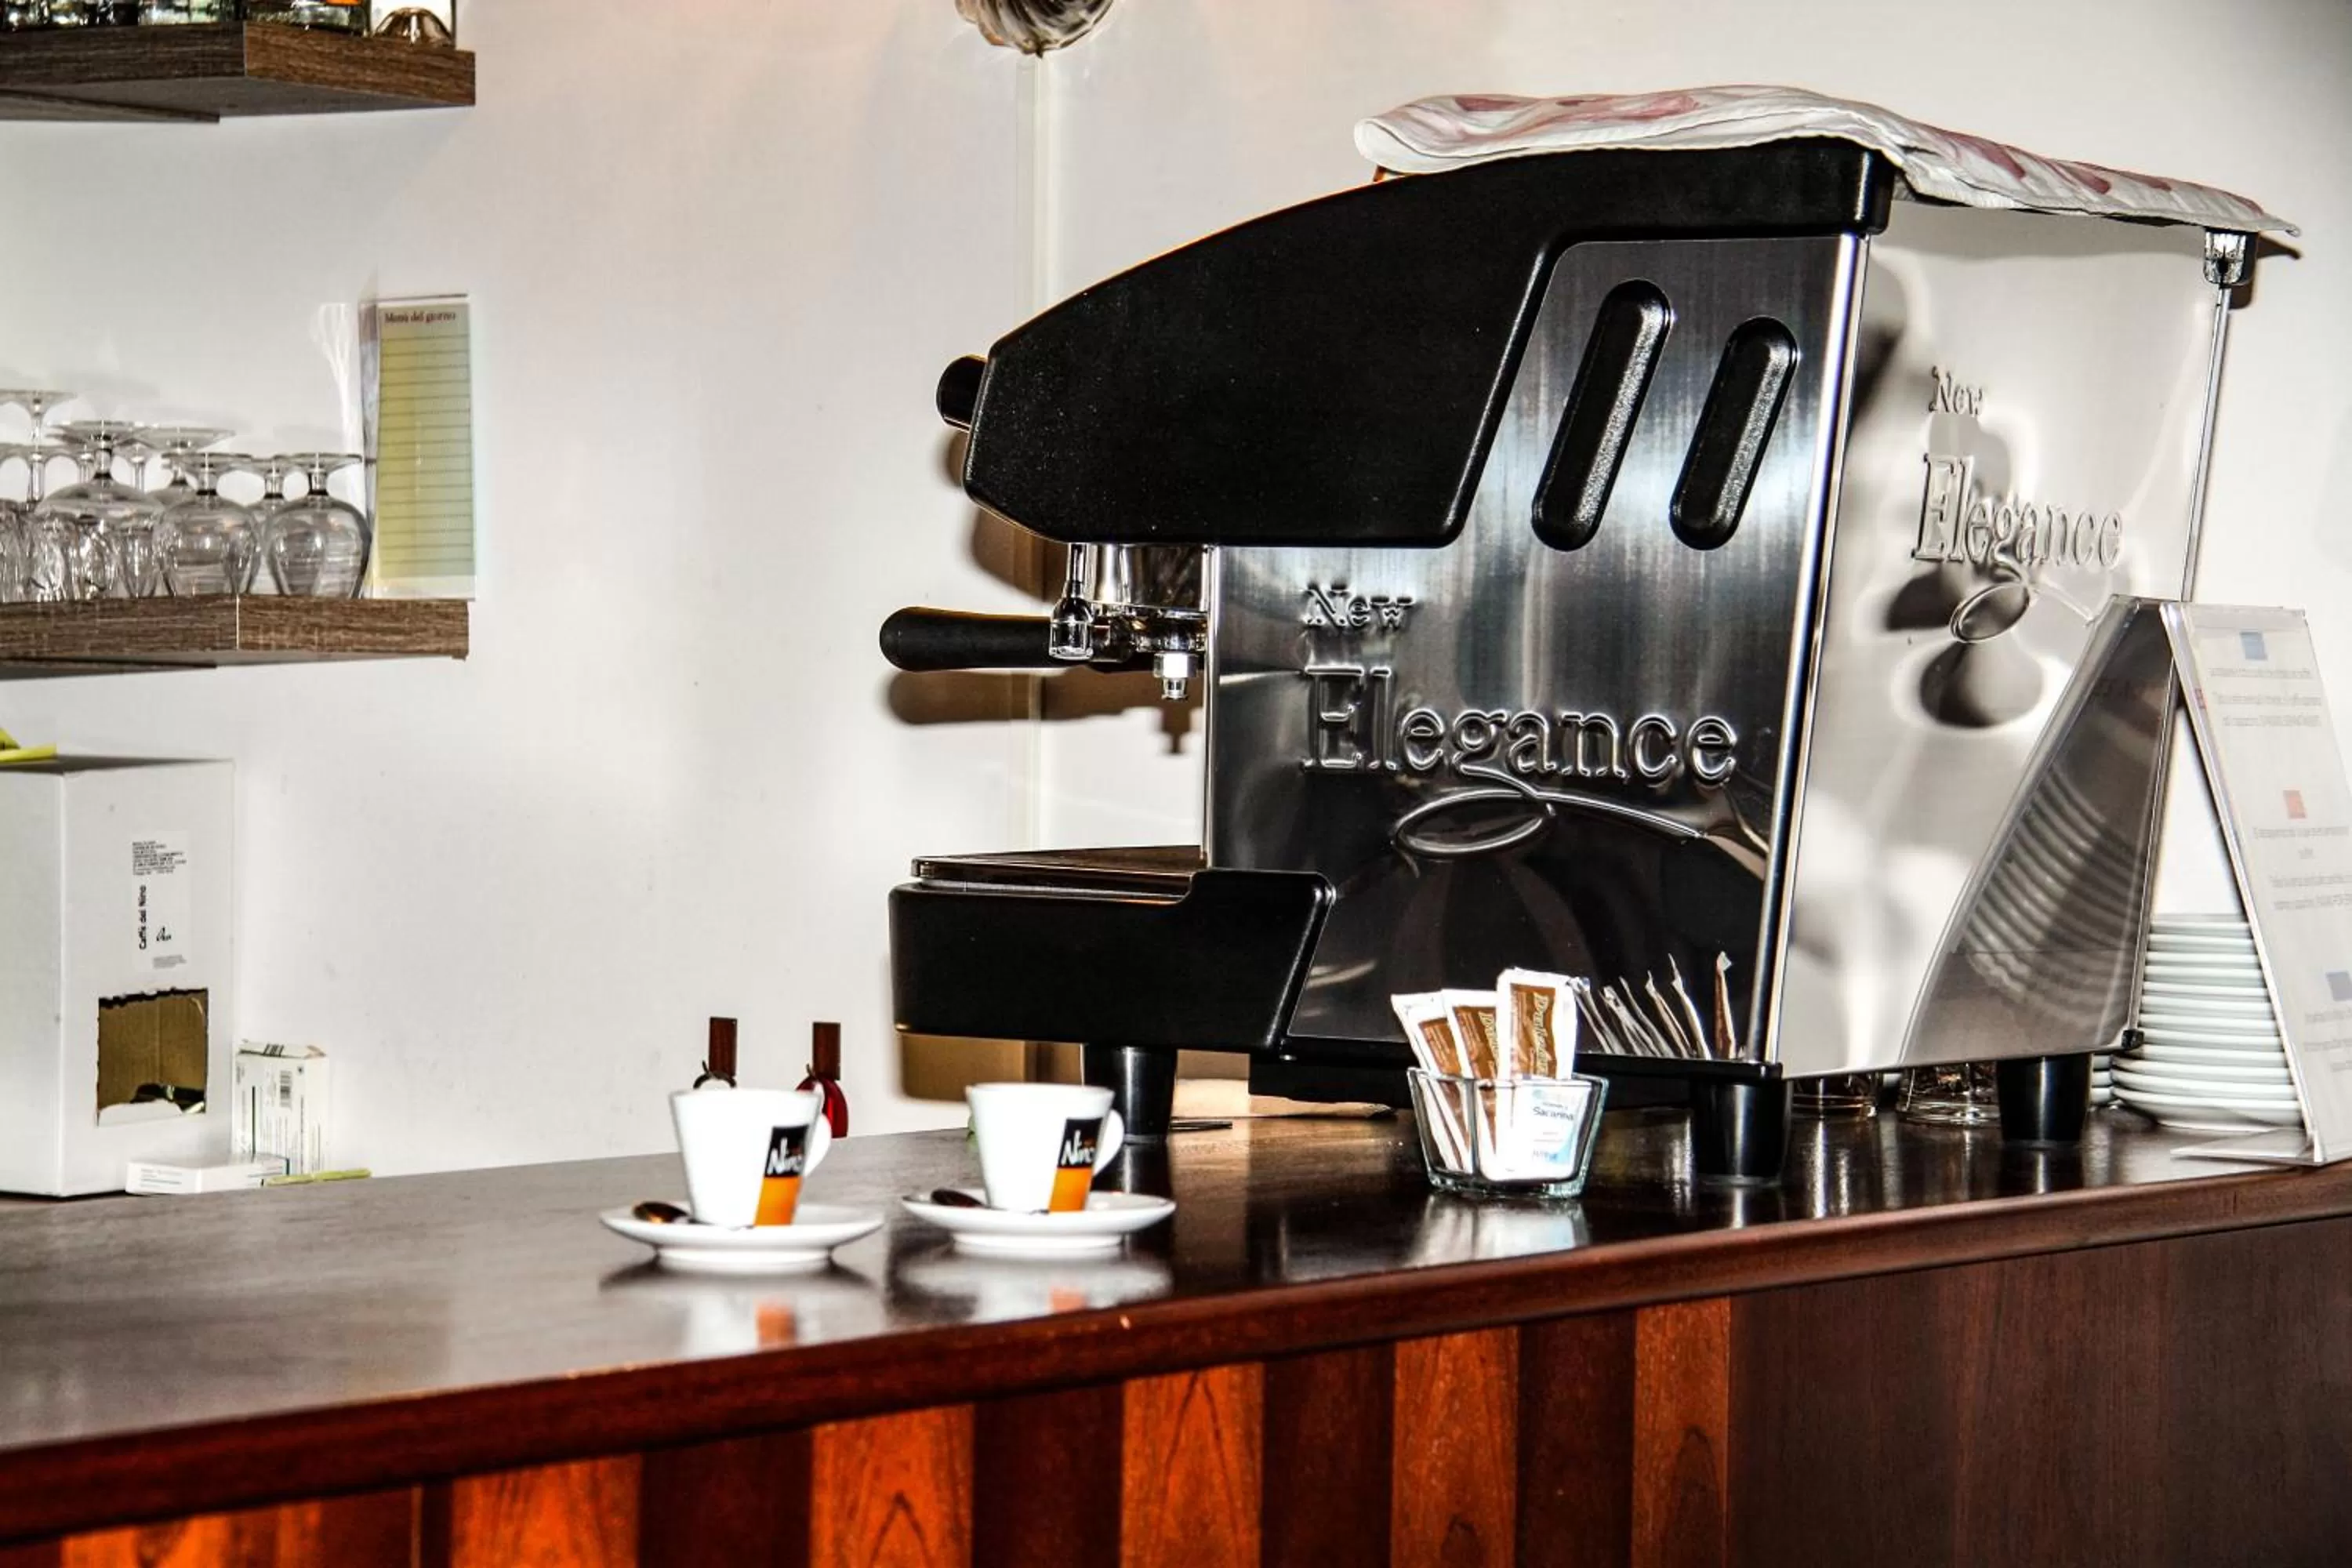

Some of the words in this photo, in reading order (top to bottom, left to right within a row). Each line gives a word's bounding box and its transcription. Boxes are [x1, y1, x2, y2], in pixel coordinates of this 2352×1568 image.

[1929, 365, 1985, 416] New
[1911, 452, 2124, 569] Elegance
[1301, 583, 1417, 630] New
[1302, 663, 1737, 790] Elegance
